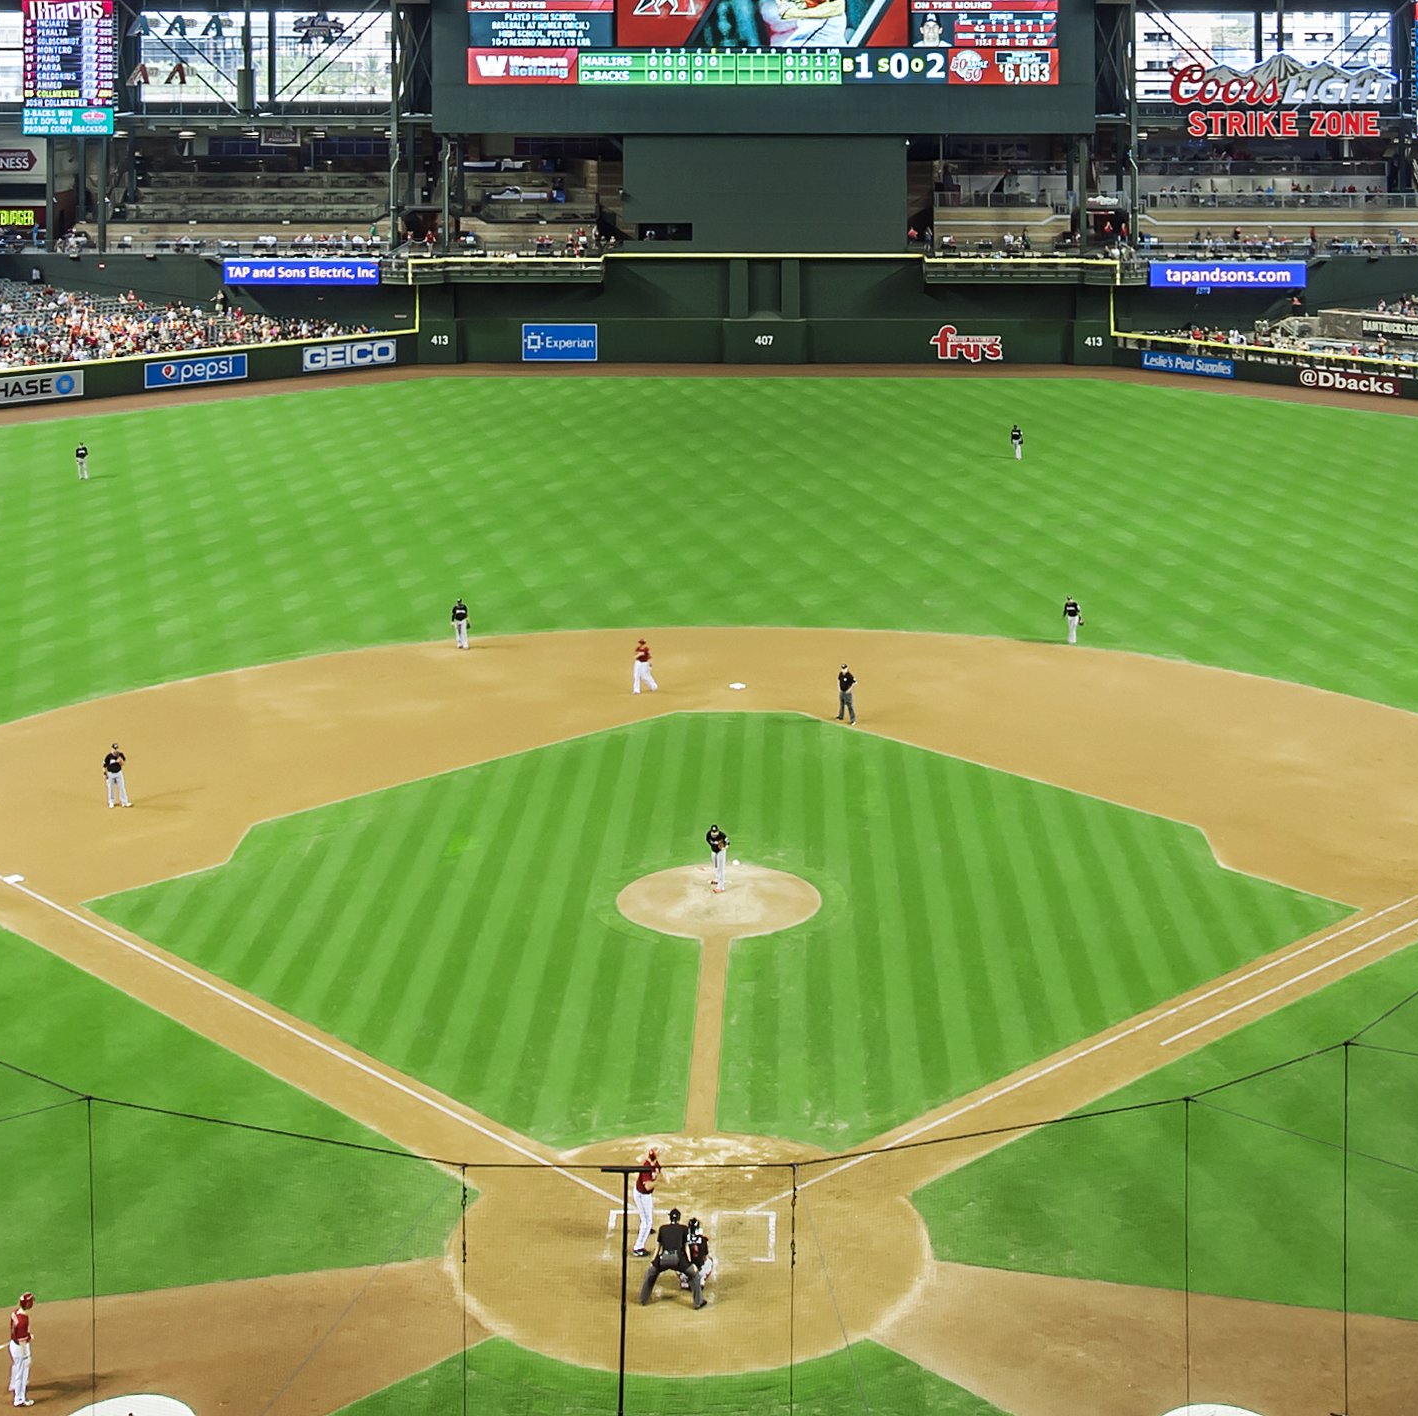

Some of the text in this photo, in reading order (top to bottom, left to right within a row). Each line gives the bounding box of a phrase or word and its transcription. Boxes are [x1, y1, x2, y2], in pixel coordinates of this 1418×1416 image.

[582, 56, 632, 66] MARLINS
[582, 71, 630, 81] D-BACKS
[1169, 64, 1393, 105] Coors LIGHT
[1188, 111, 1380, 136] STRIKE ZONE
[227, 266, 375, 280] TAP and Sons Electric, Inc
[1166, 268, 1291, 284] tapandsons.com
[431, 335, 449, 345] 413
[546, 336, 594, 350] Experian
[754, 335, 774, 347] 407
[930, 324, 1003, 362] fry's
[1084, 336, 1103, 347] 413
[304, 342, 397, 370] GEICO
[180, 357, 234, 383] pepsi
[1143, 354, 1231, 375] Leslie's Pool Supplies
[1299, 369, 1394, 395] @Dbacks
